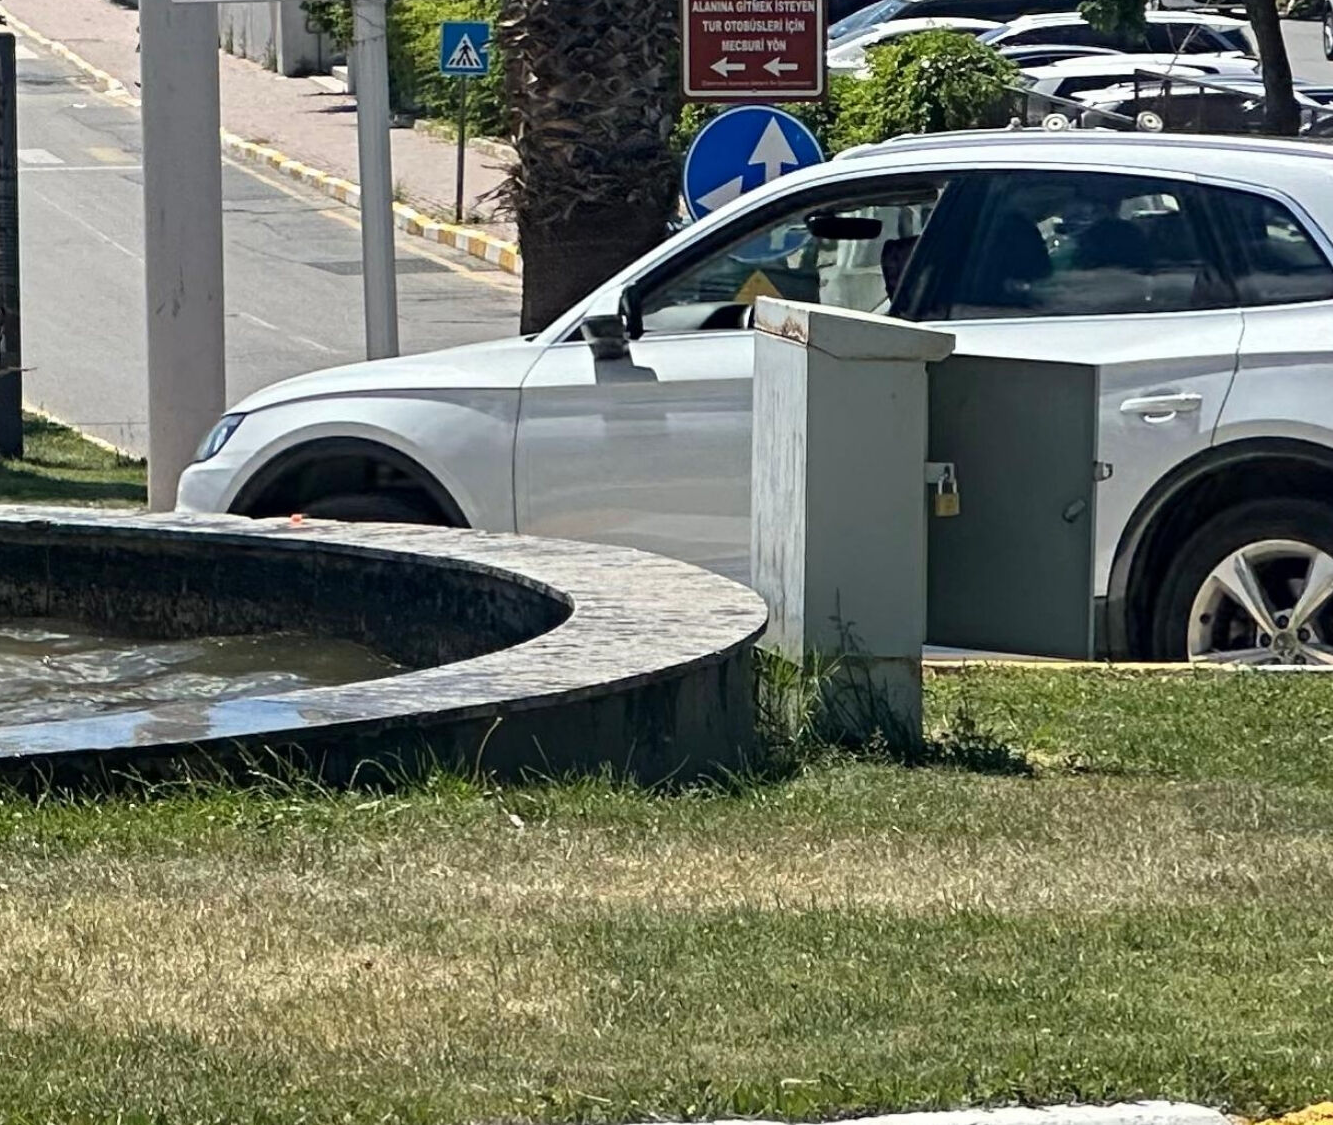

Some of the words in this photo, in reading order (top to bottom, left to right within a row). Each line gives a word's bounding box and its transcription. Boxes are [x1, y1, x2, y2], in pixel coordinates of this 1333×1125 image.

[692, 1, 734, 12] ALANINA
[736, 0, 773, 12] GİTMEK
[702, 20, 722, 32] TUR
[724, 17, 783, 32] OTOBÜSLERİ
[785, 17, 806, 34] İÇİN
[721, 37, 764, 52] MECBURİ
[766, 37, 787, 52] YÖN
